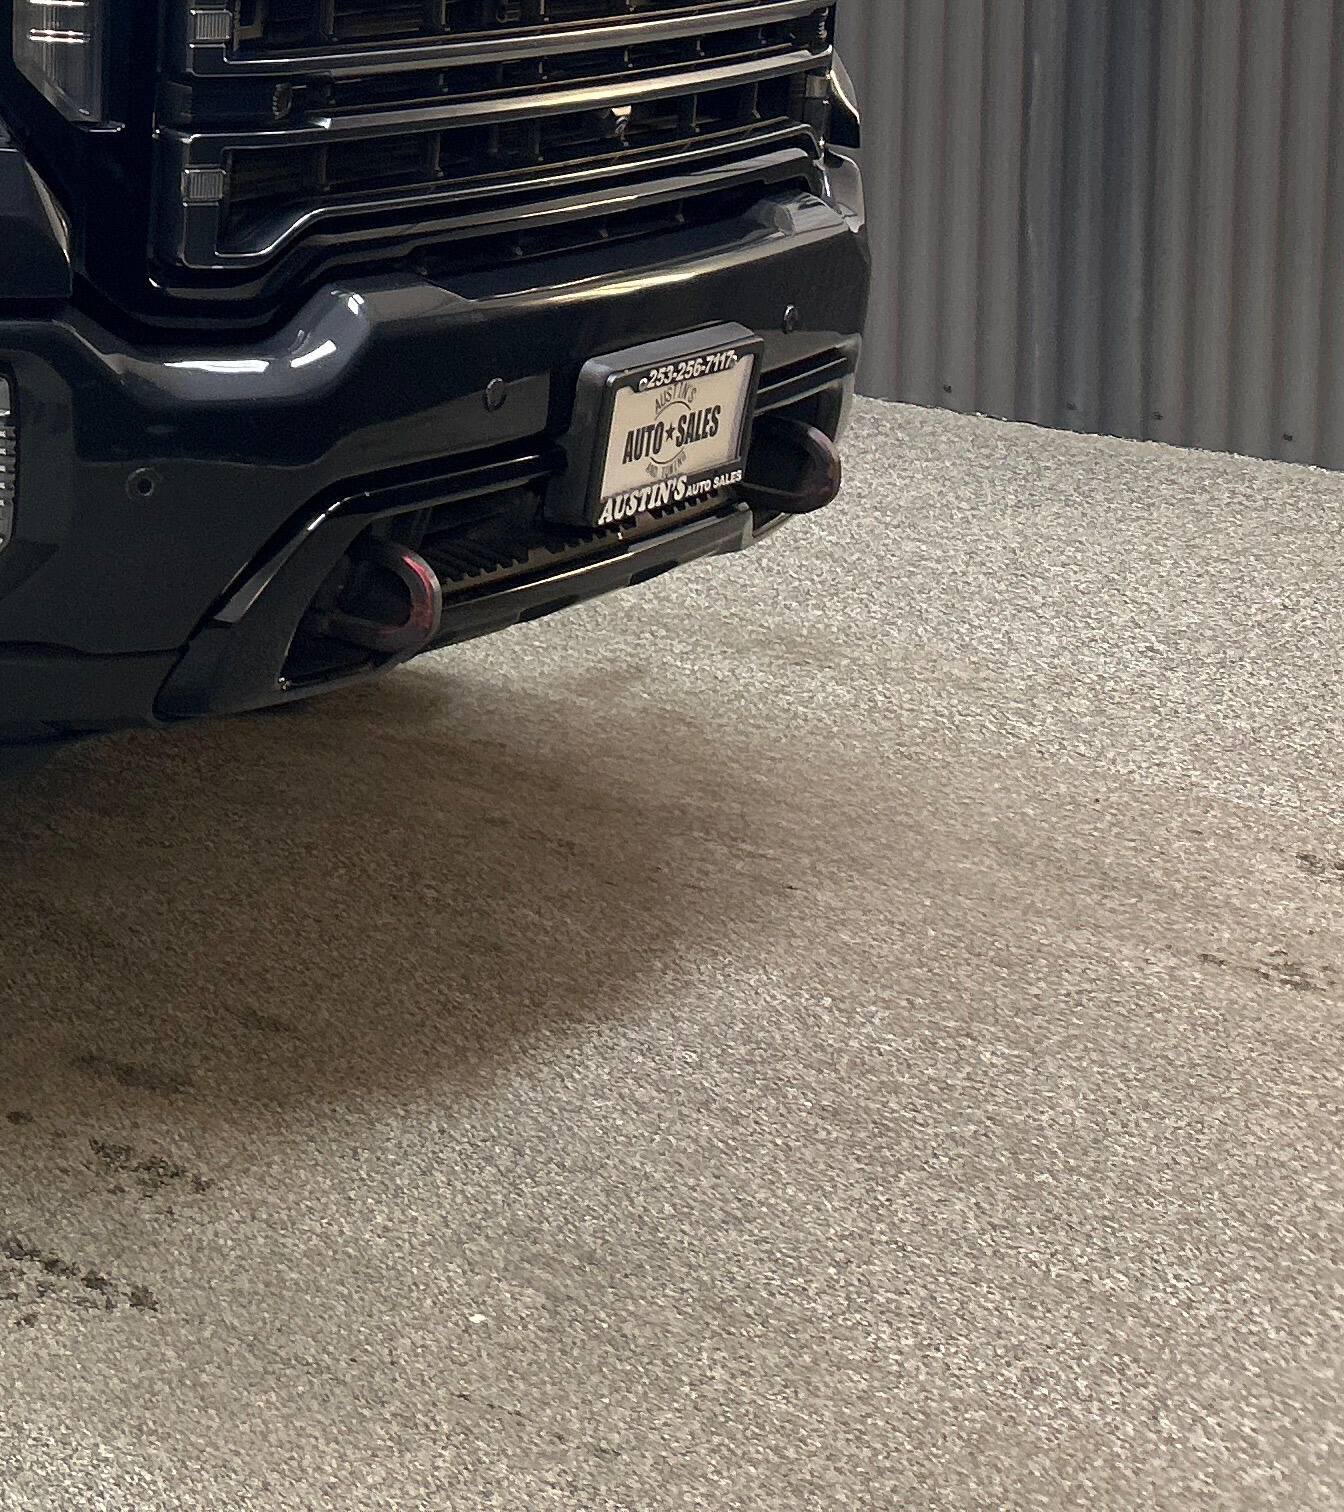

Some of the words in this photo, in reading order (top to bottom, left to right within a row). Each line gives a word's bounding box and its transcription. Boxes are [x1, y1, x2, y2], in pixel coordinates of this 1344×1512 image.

[647, 349, 736, 389] 253-256-7117
[655, 381, 697, 412] AUSTIN'S
[621, 421, 665, 465] AUTO
[675, 404, 721, 448] SALES
[598, 475, 688, 525] AUSTIN'S
[687, 480, 712, 497] AUTO
[713, 469, 743, 489] SALES
